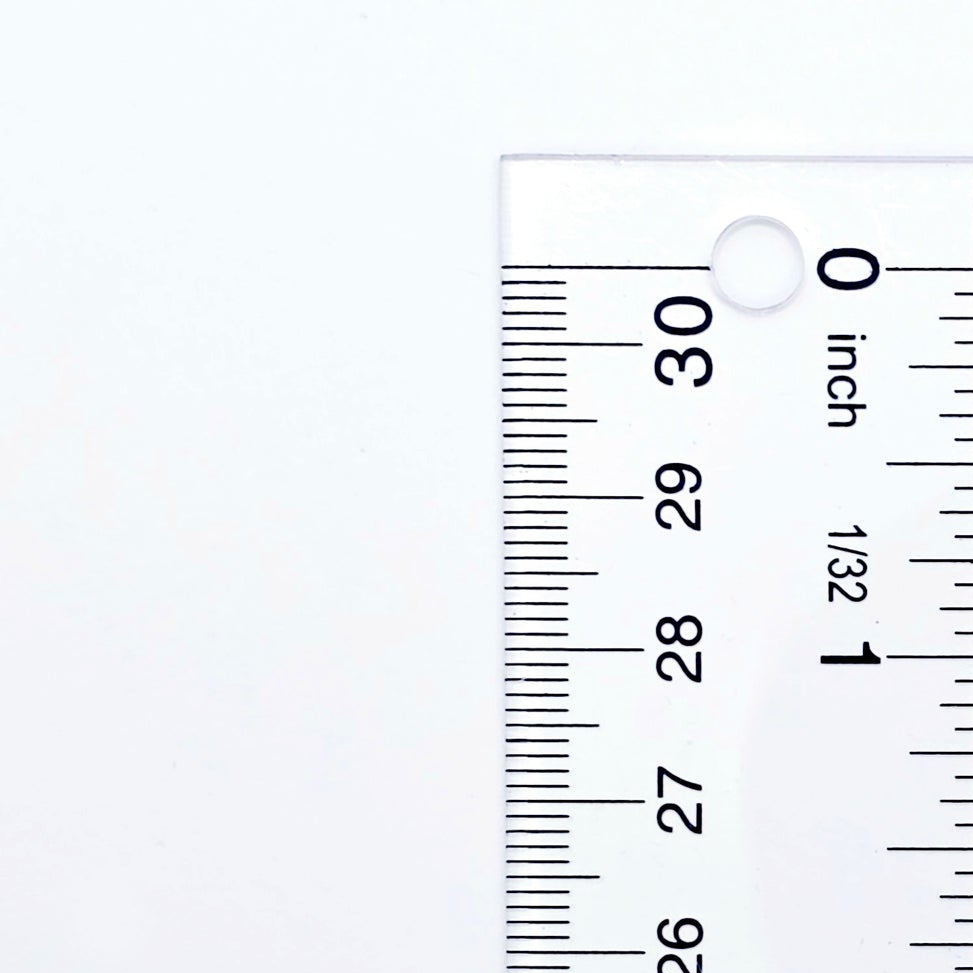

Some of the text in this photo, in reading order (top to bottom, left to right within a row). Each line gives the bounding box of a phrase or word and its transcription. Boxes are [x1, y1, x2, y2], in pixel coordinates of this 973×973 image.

[816, 247, 880, 291] 0
[653, 295, 713, 388] 30
[827, 334, 867, 429] inch
[654, 462, 703, 532] 29
[827, 524, 868, 603] 1/32
[655, 614, 703, 683] 28
[820, 641, 882, 665] 1
[657, 765, 703, 835] 27
